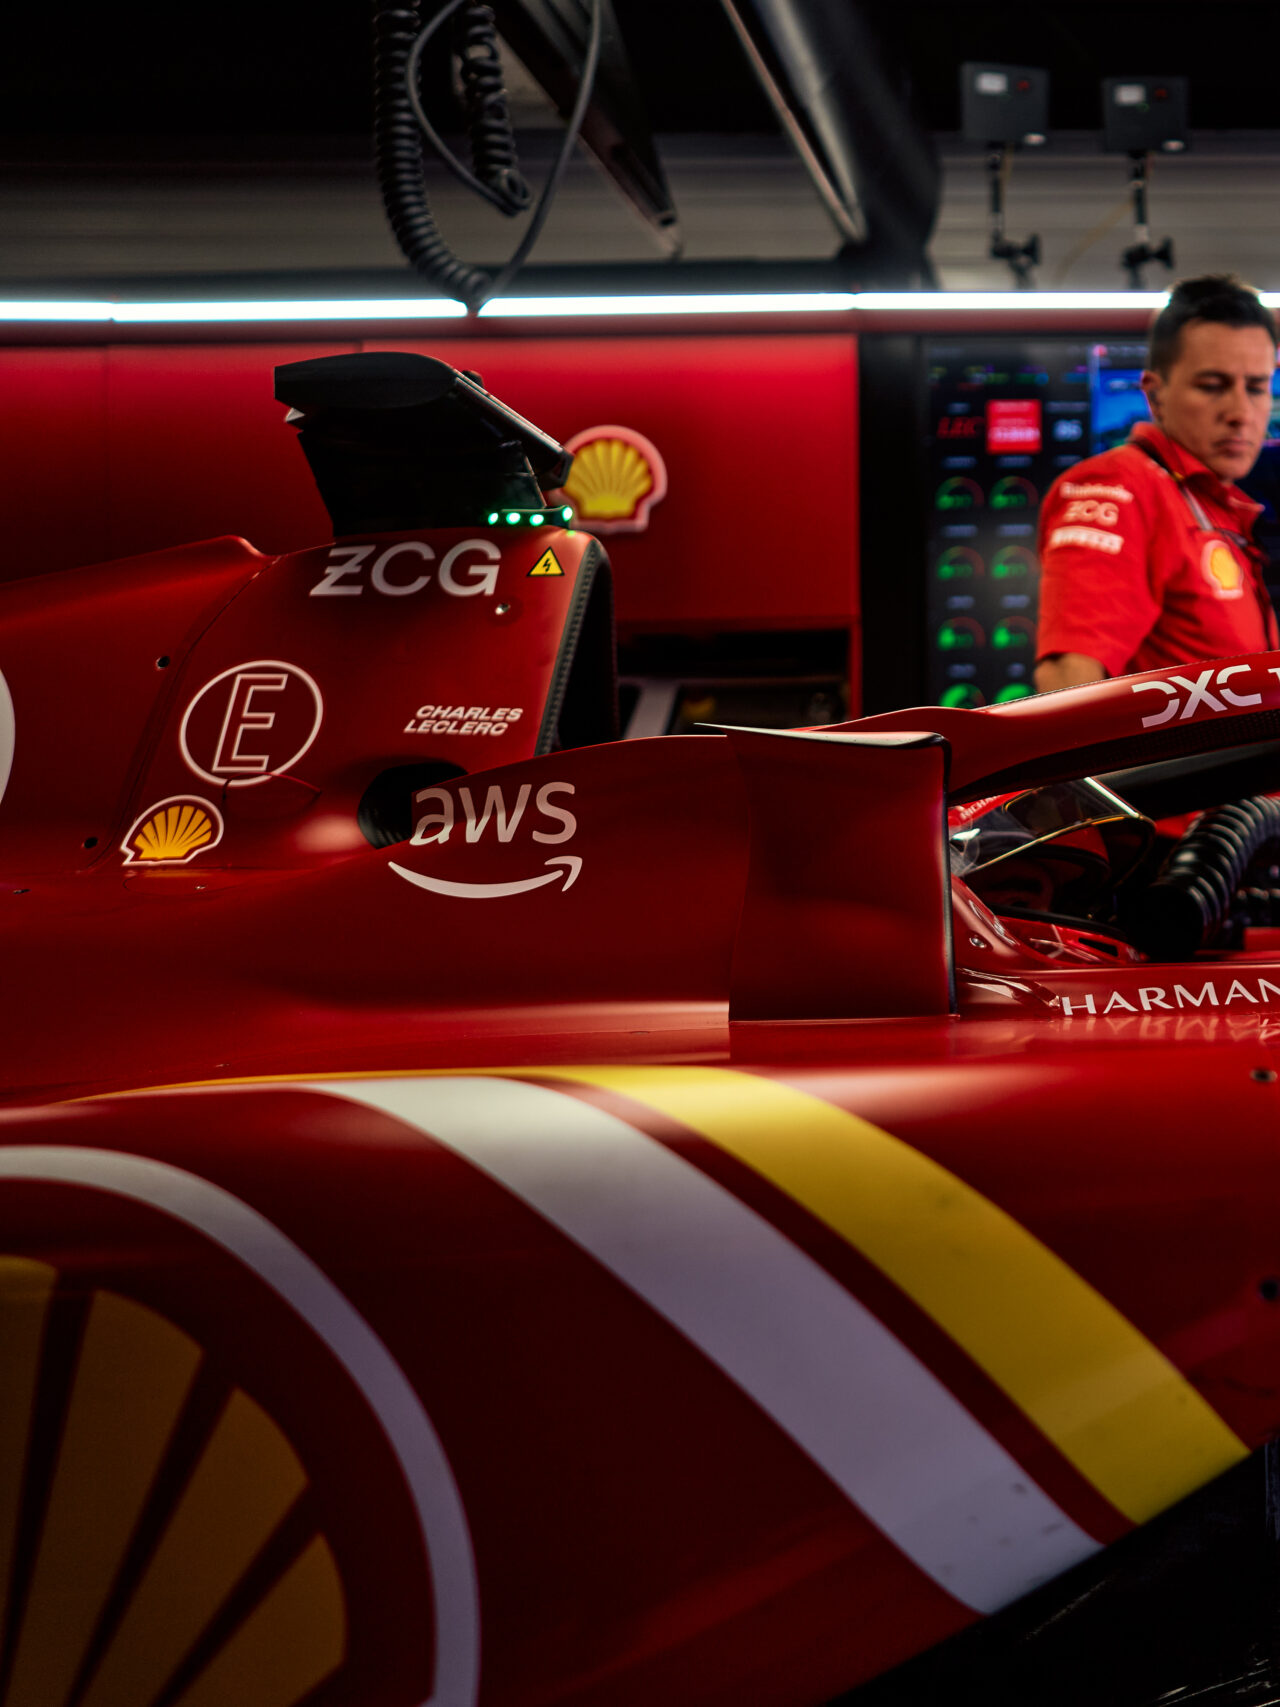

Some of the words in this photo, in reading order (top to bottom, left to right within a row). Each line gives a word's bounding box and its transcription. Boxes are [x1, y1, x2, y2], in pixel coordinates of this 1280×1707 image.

[309, 539, 501, 597] ZCG
[211, 673, 288, 772] E
[416, 705, 523, 722] CHARLES
[1132, 664, 1262, 728] DXC
[403, 719, 508, 736] LECLERC
[409, 781, 577, 846] aws
